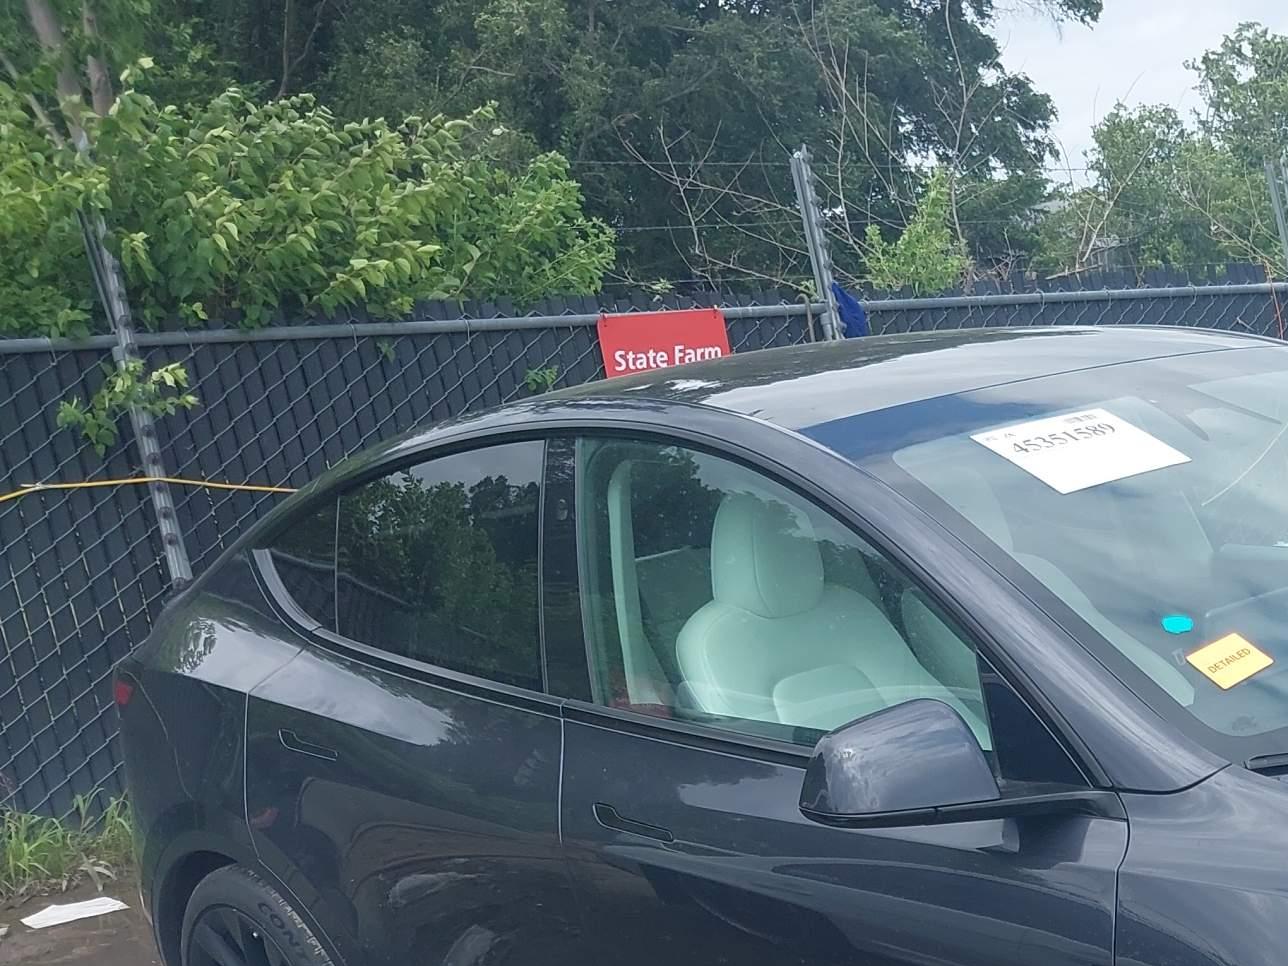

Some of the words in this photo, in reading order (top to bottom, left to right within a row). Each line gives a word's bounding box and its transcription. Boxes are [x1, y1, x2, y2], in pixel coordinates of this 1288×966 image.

[614, 348, 668, 371] State
[674, 345, 721, 365] Farm
[1013, 422, 1116, 454] 45351589
[1207, 647, 1251, 674] DETAILED
